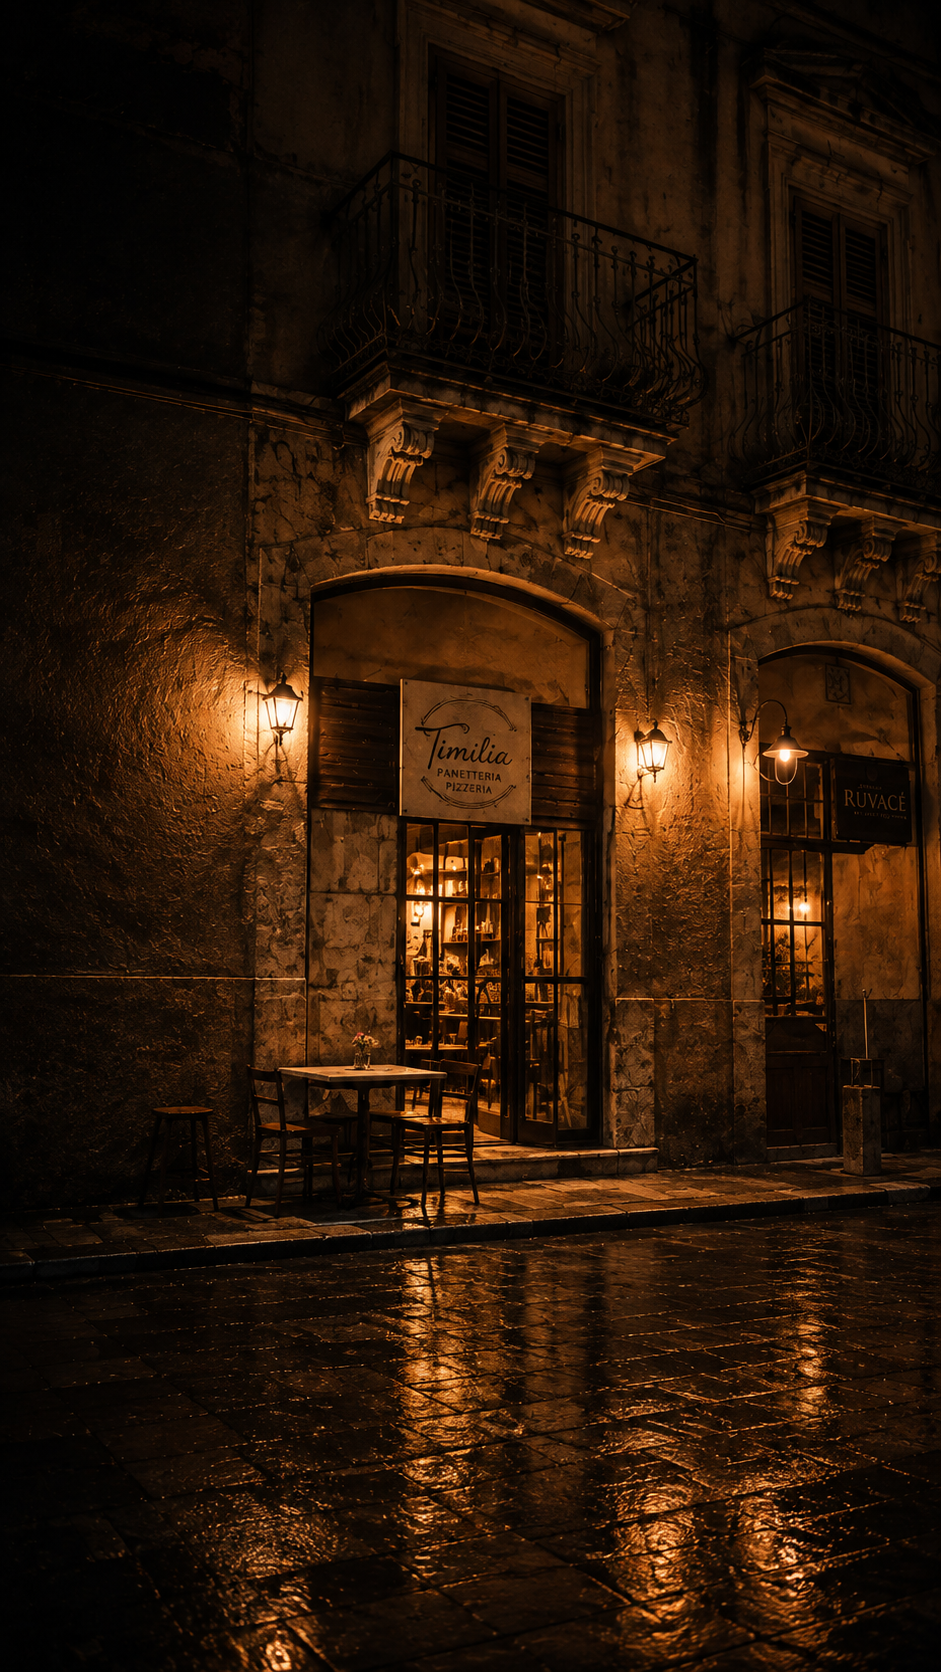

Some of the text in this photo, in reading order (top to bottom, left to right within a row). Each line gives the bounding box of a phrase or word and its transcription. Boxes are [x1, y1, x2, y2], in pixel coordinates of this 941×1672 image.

[415, 723, 513, 769] Timilia
[437, 768, 502, 782] PANETTERIA
[446, 782, 492, 794] PIZZERIA
[844, 789, 907, 812] RUVACÉ
